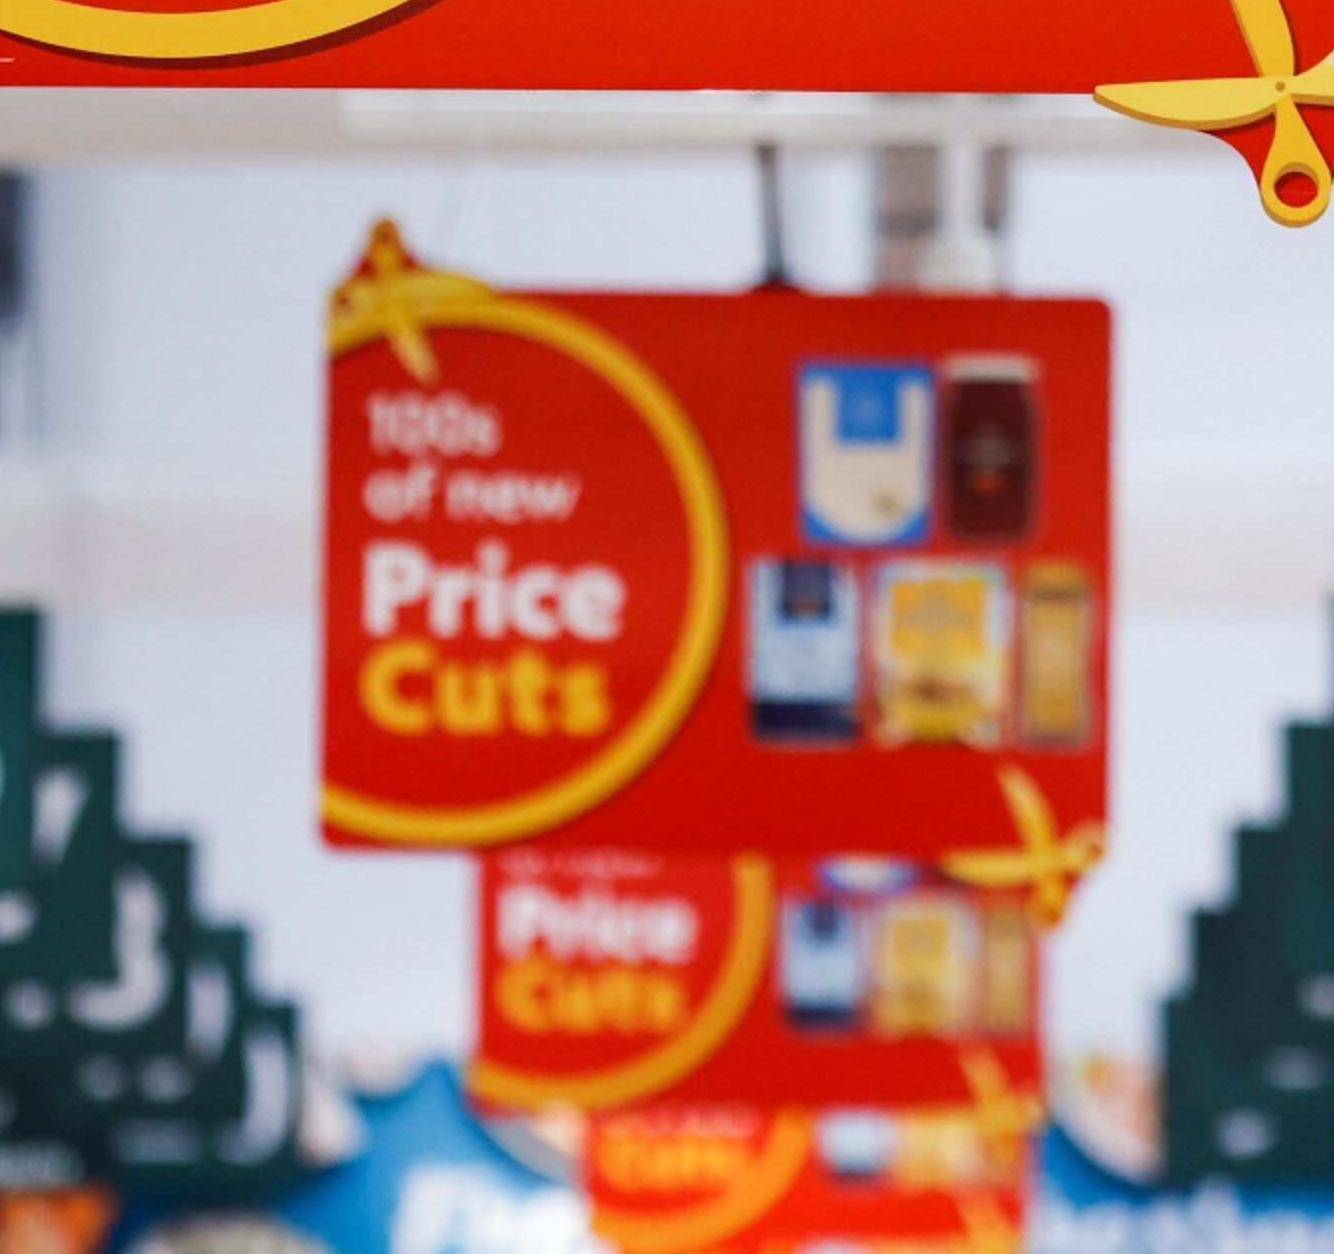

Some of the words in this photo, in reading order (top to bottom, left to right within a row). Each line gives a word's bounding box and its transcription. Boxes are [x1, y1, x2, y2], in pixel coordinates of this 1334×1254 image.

[365, 390, 503, 457] 100s
[363, 456, 437, 522] of
[444, 470, 581, 524] new
[362, 535, 628, 643] Price
[359, 639, 610, 737] Cuts
[494, 879, 698, 965] Price
[493, 951, 685, 1035] Cuts
